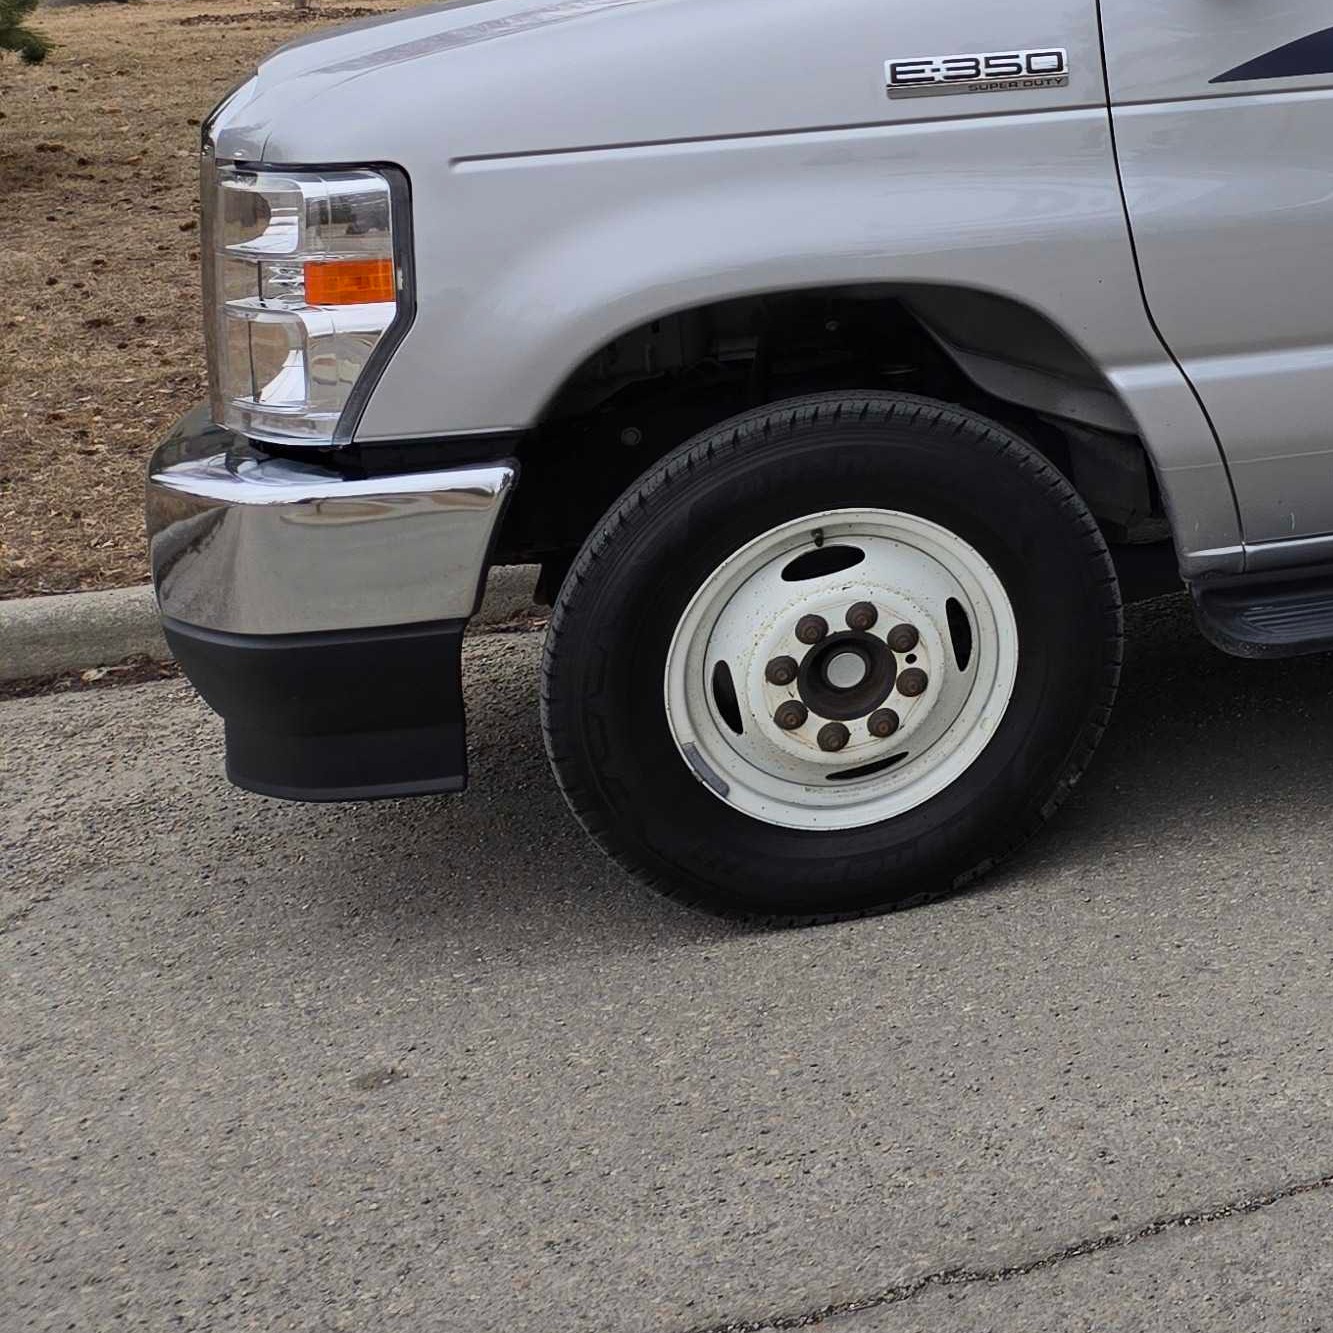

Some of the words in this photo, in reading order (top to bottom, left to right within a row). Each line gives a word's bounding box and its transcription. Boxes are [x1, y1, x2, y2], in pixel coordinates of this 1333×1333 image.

[889, 50, 1064, 84] E-350
[968, 81, 1019, 92] SUPER
[1022, 76, 1063, 87] DUTY
